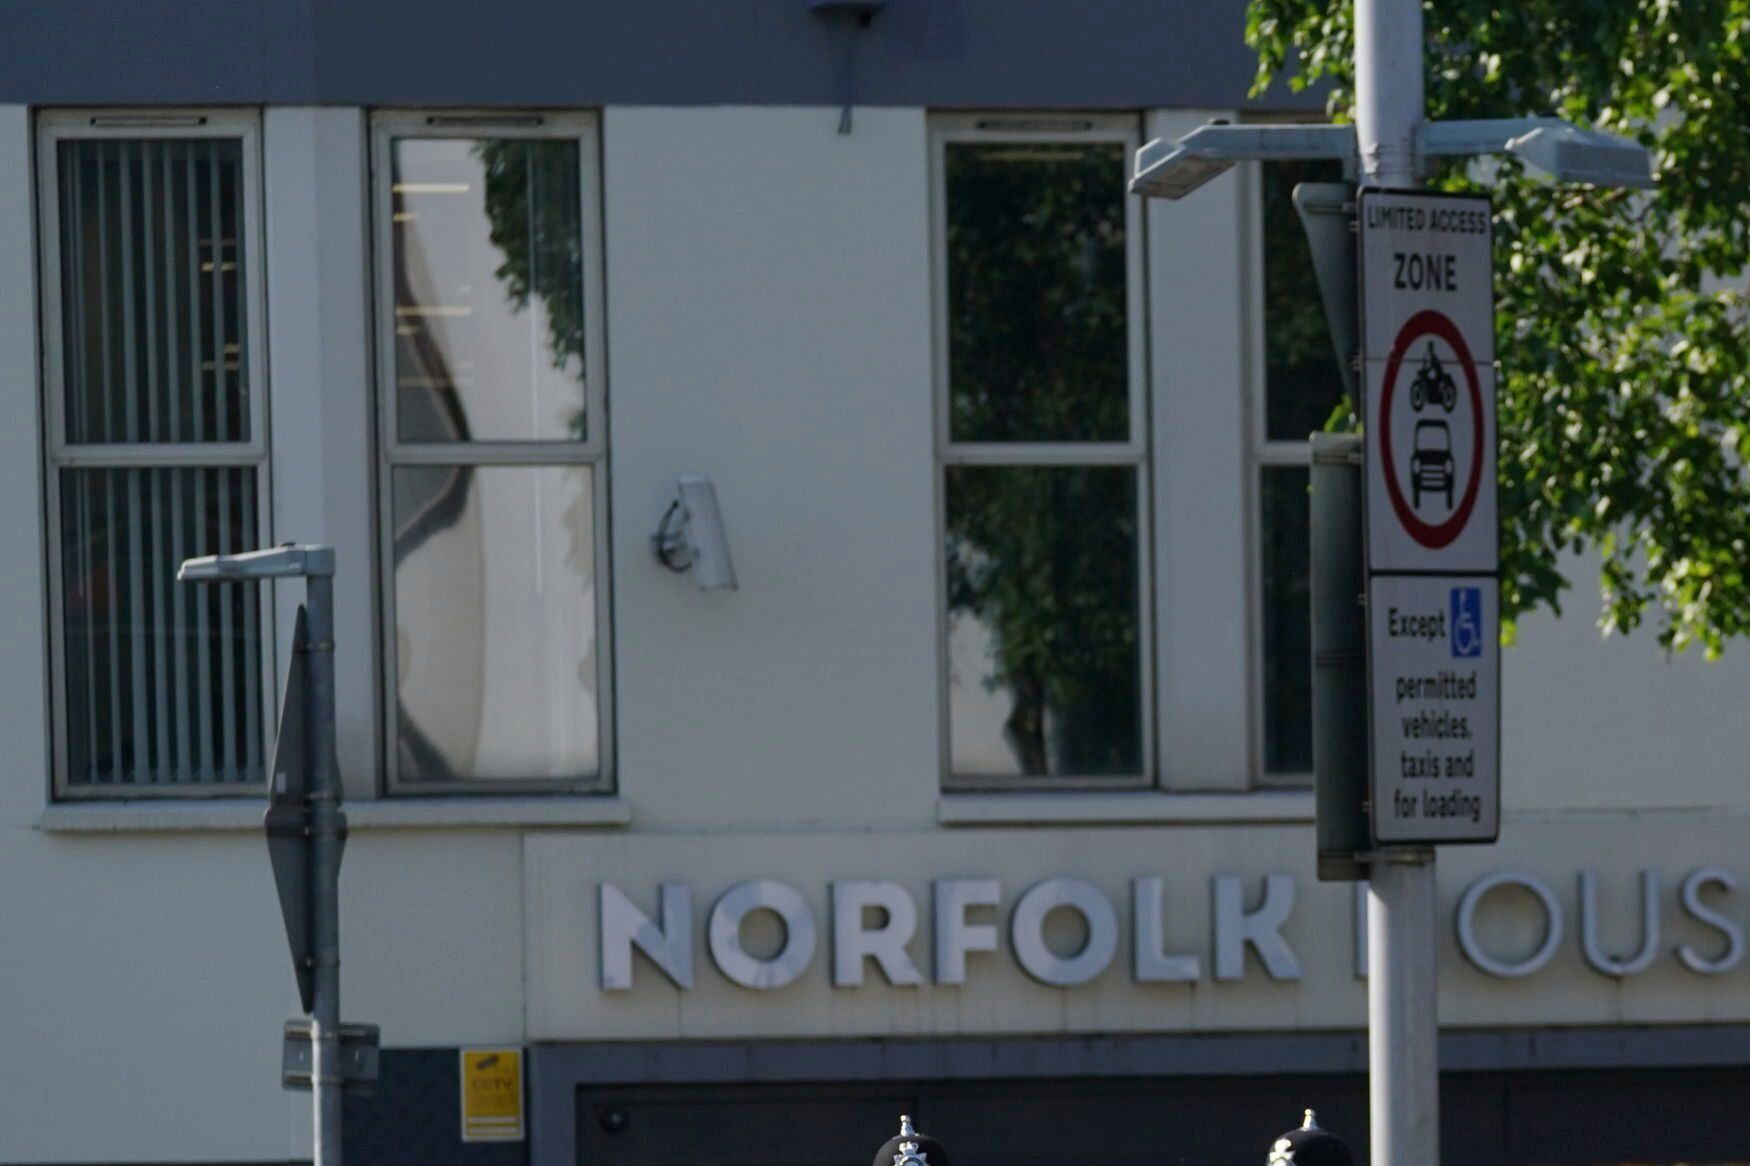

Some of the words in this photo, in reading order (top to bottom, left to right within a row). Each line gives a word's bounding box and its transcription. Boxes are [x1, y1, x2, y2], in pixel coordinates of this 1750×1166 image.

[1367, 205, 1425, 231] LIMITED
[1429, 208, 1487, 235] ACCESS
[1393, 251, 1458, 292] ZONE
[1389, 607, 1446, 643] Except
[1395, 670, 1477, 705] permitted
[1401, 751, 1440, 778] taxis
[1444, 750, 1474, 778] and
[1394, 789, 1416, 819] for
[1422, 789, 1481, 823] loading
[597, 875, 1303, 991] NORFOLK
